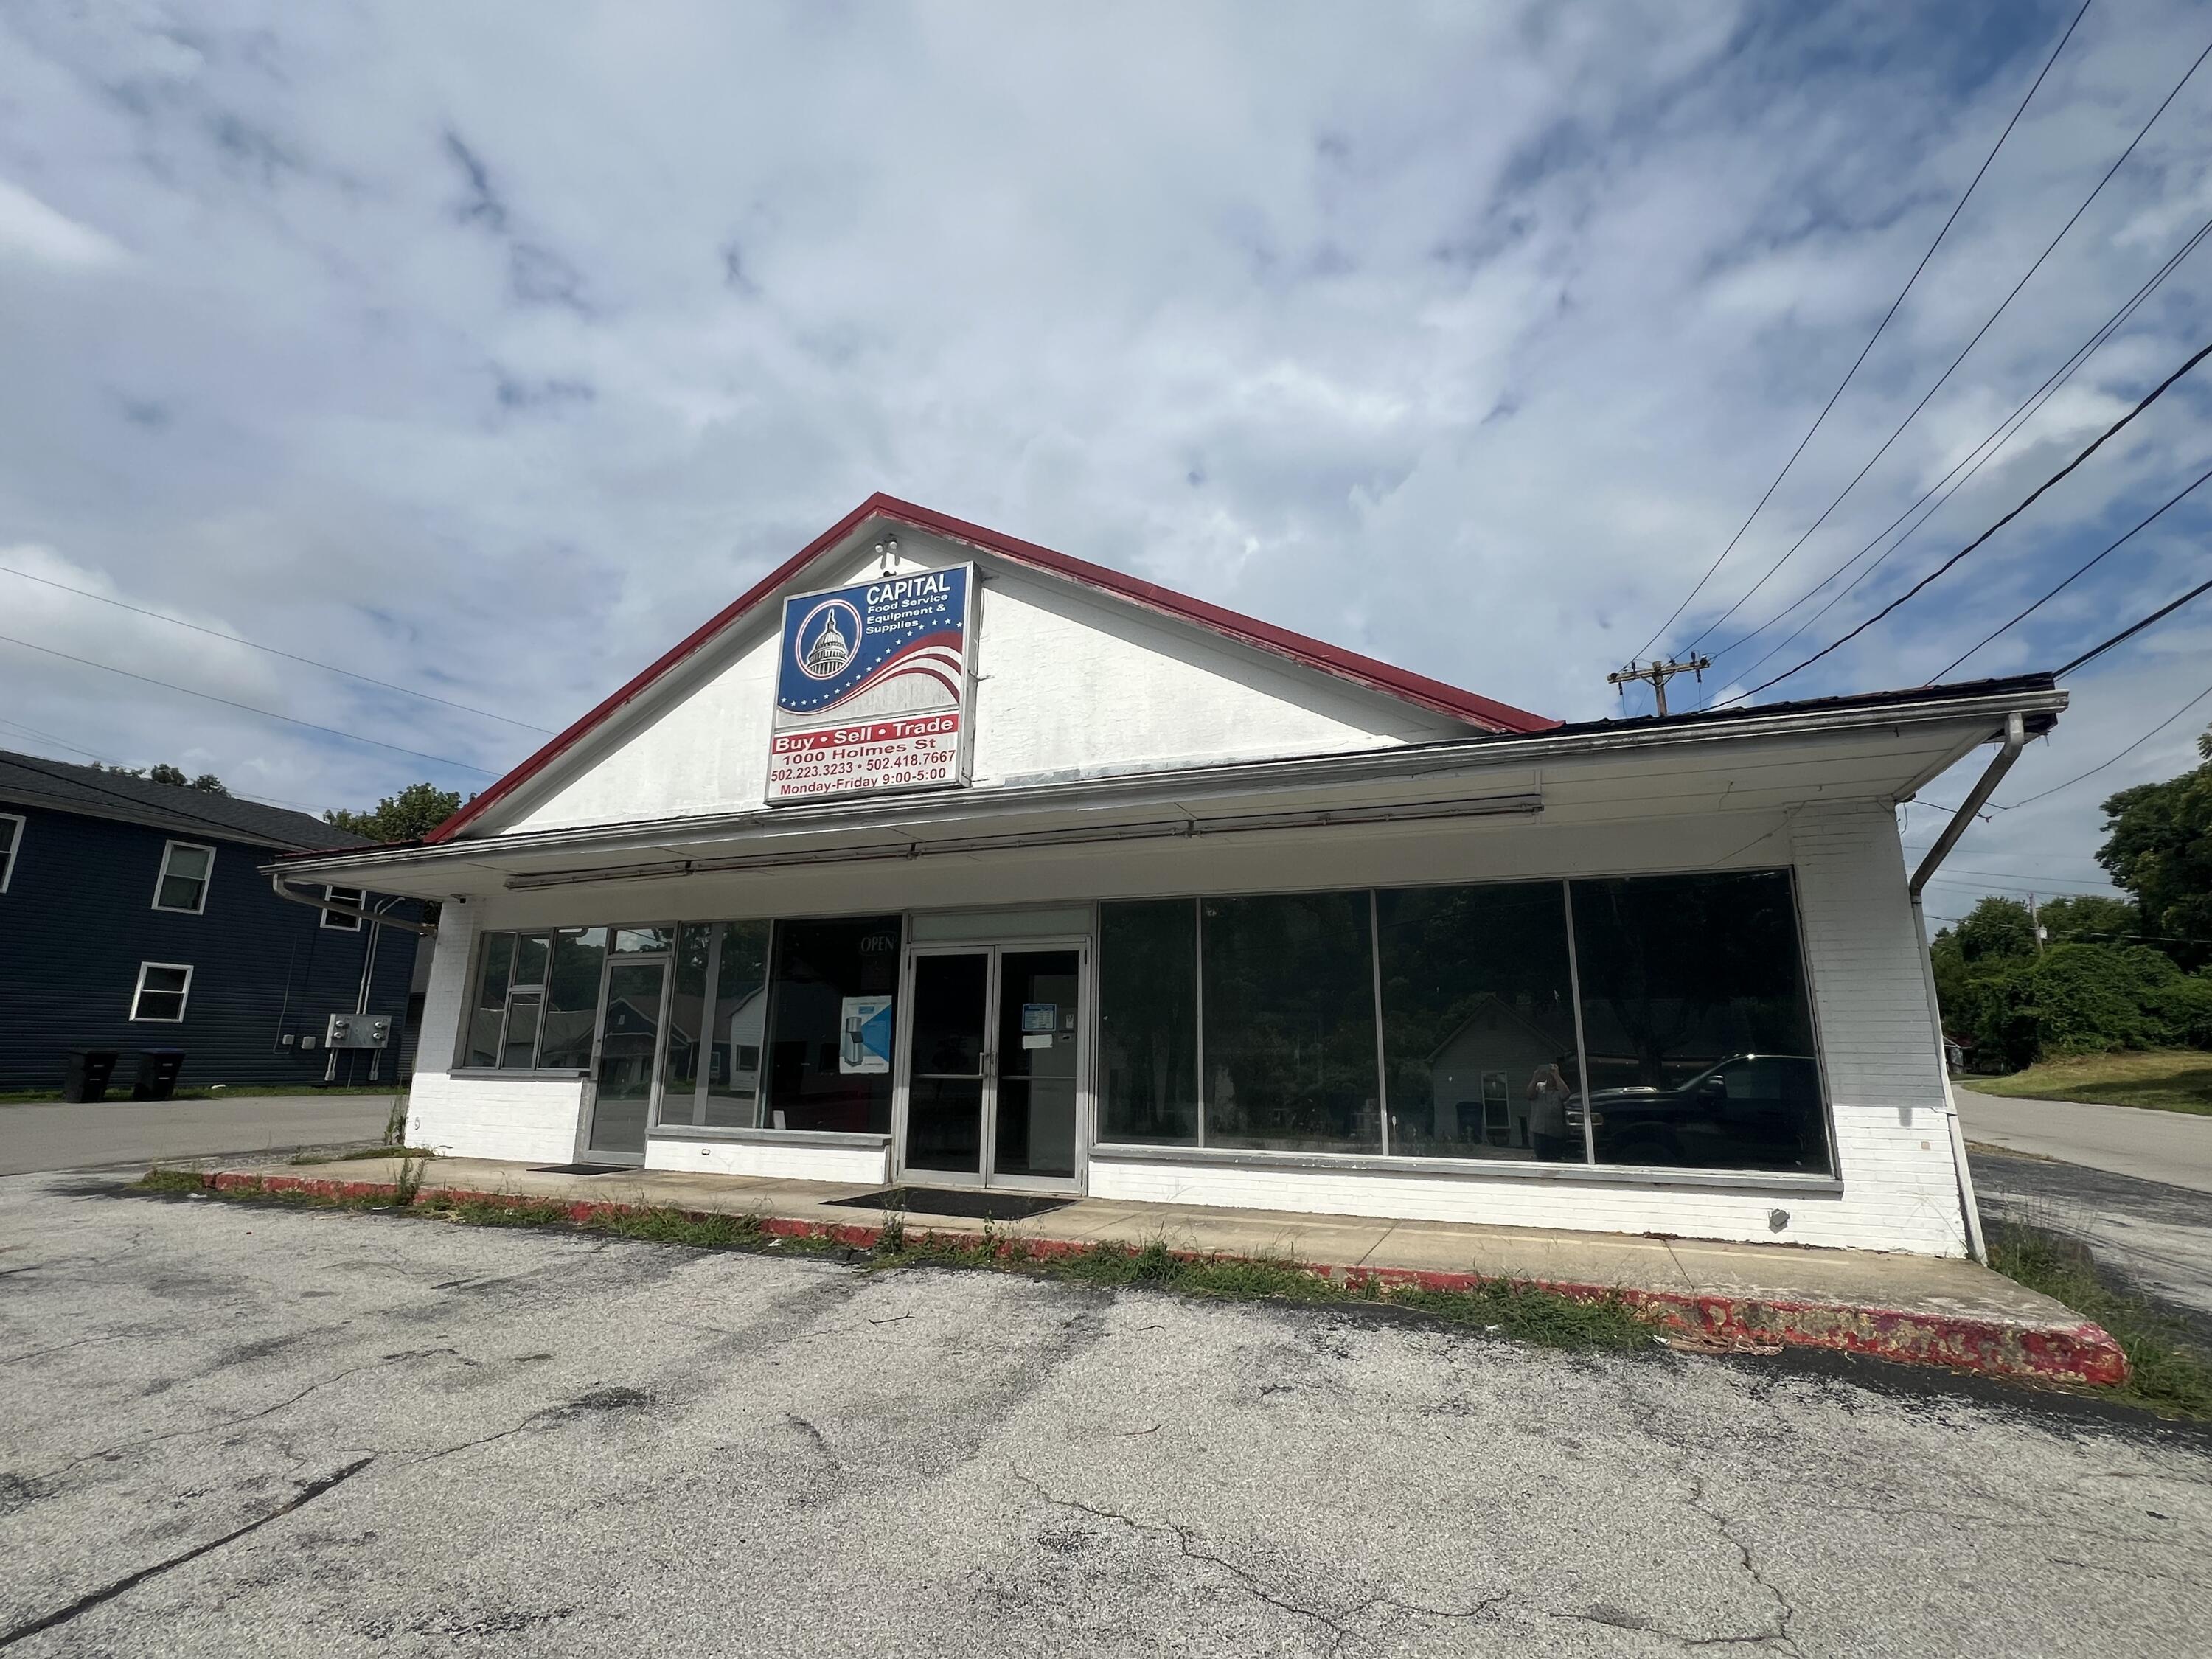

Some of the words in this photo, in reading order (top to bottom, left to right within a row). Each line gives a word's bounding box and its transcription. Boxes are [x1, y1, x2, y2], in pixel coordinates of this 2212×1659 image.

[866, 574, 950, 605] CAPITAL
[866, 606, 933, 625] Equipment
[936, 603, 946, 612] &
[867, 602, 898, 613] Food
[901, 594, 948, 608] Service
[866, 619, 919, 634] Supplies
[776, 737, 815, 751] Buy
[833, 726, 872, 744] Sell
[893, 717, 953, 737] Trade
[782, 751, 825, 765] 1000
[832, 743, 907, 760] Holmes
[914, 738, 936, 750] St
[771, 762, 853, 782] 502.223.3233
[866, 749, 956, 771] 502.418.7667
[780, 776, 878, 795] Monday-Friday
[883, 768, 946, 785] 9:00-5:00
[860, 936, 894, 952] OPEN
